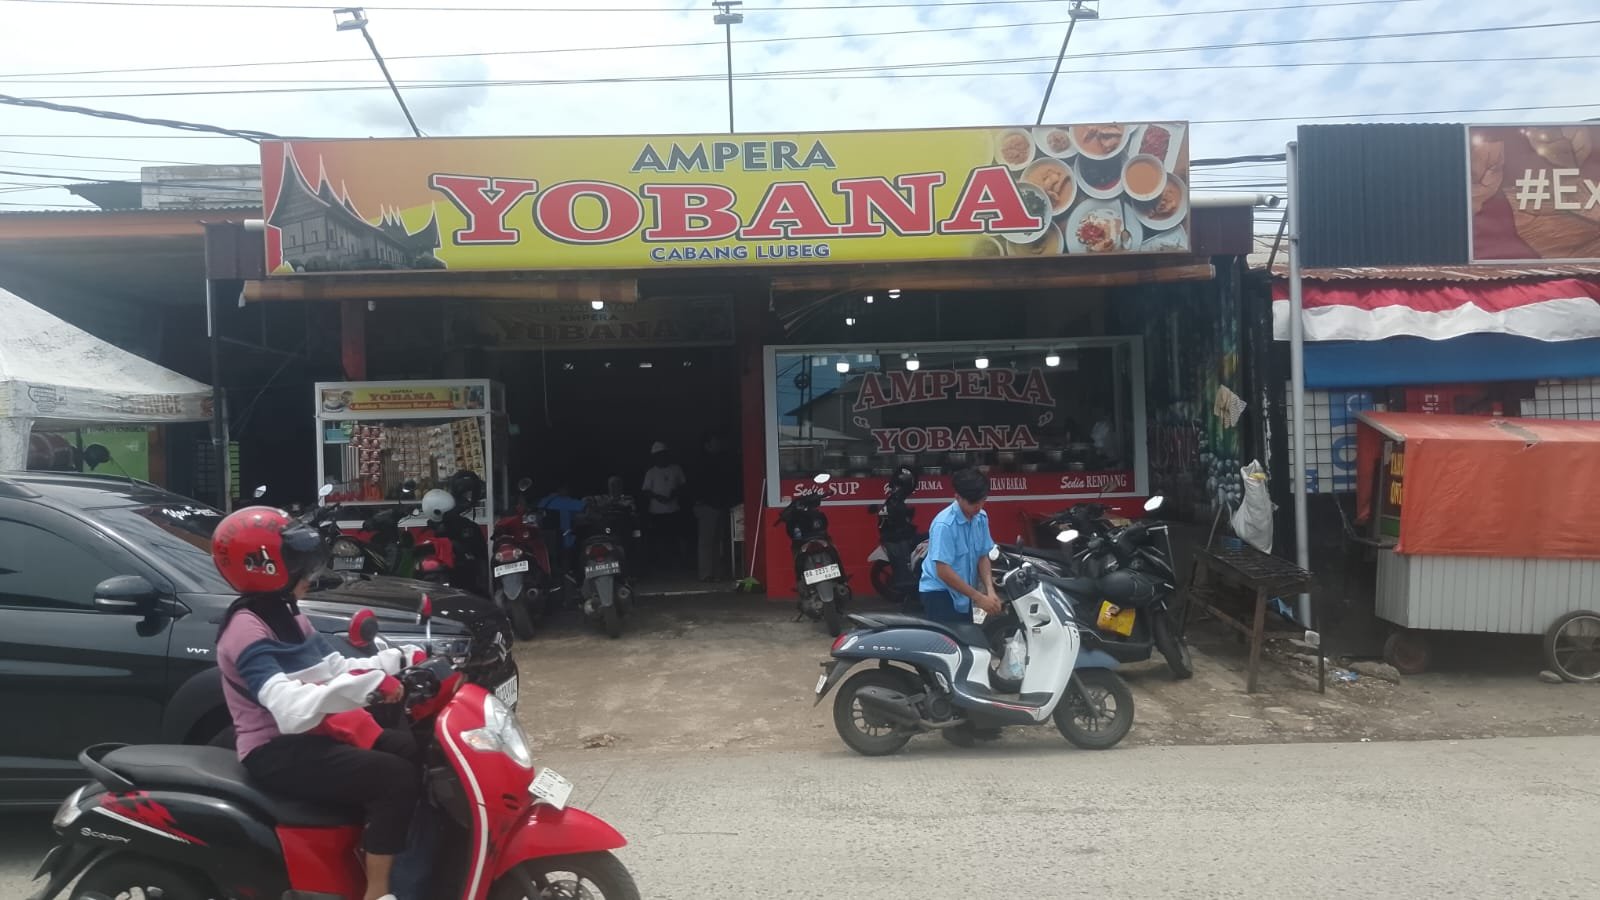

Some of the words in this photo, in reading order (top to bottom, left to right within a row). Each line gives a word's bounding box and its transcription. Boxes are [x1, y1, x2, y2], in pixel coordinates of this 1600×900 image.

[629, 139, 837, 173] AMPERA
[429, 165, 1044, 246] YOBANA
[650, 244, 748, 262] CABANG
[755, 242, 831, 260] LUBEG
[368, 391, 436, 402] YOBANA
[852, 368, 1056, 412] AMPERA
[871, 425, 1039, 453] YOBANA
[828, 481, 860, 496] SUP
[990, 478, 1006, 490] IKAN
[1006, 477, 1028, 490] BAKAR
[1060, 475, 1085, 489] Sedia
[1086, 474, 1127, 488] RENDANG
[187, 647, 210, 655] VVT
